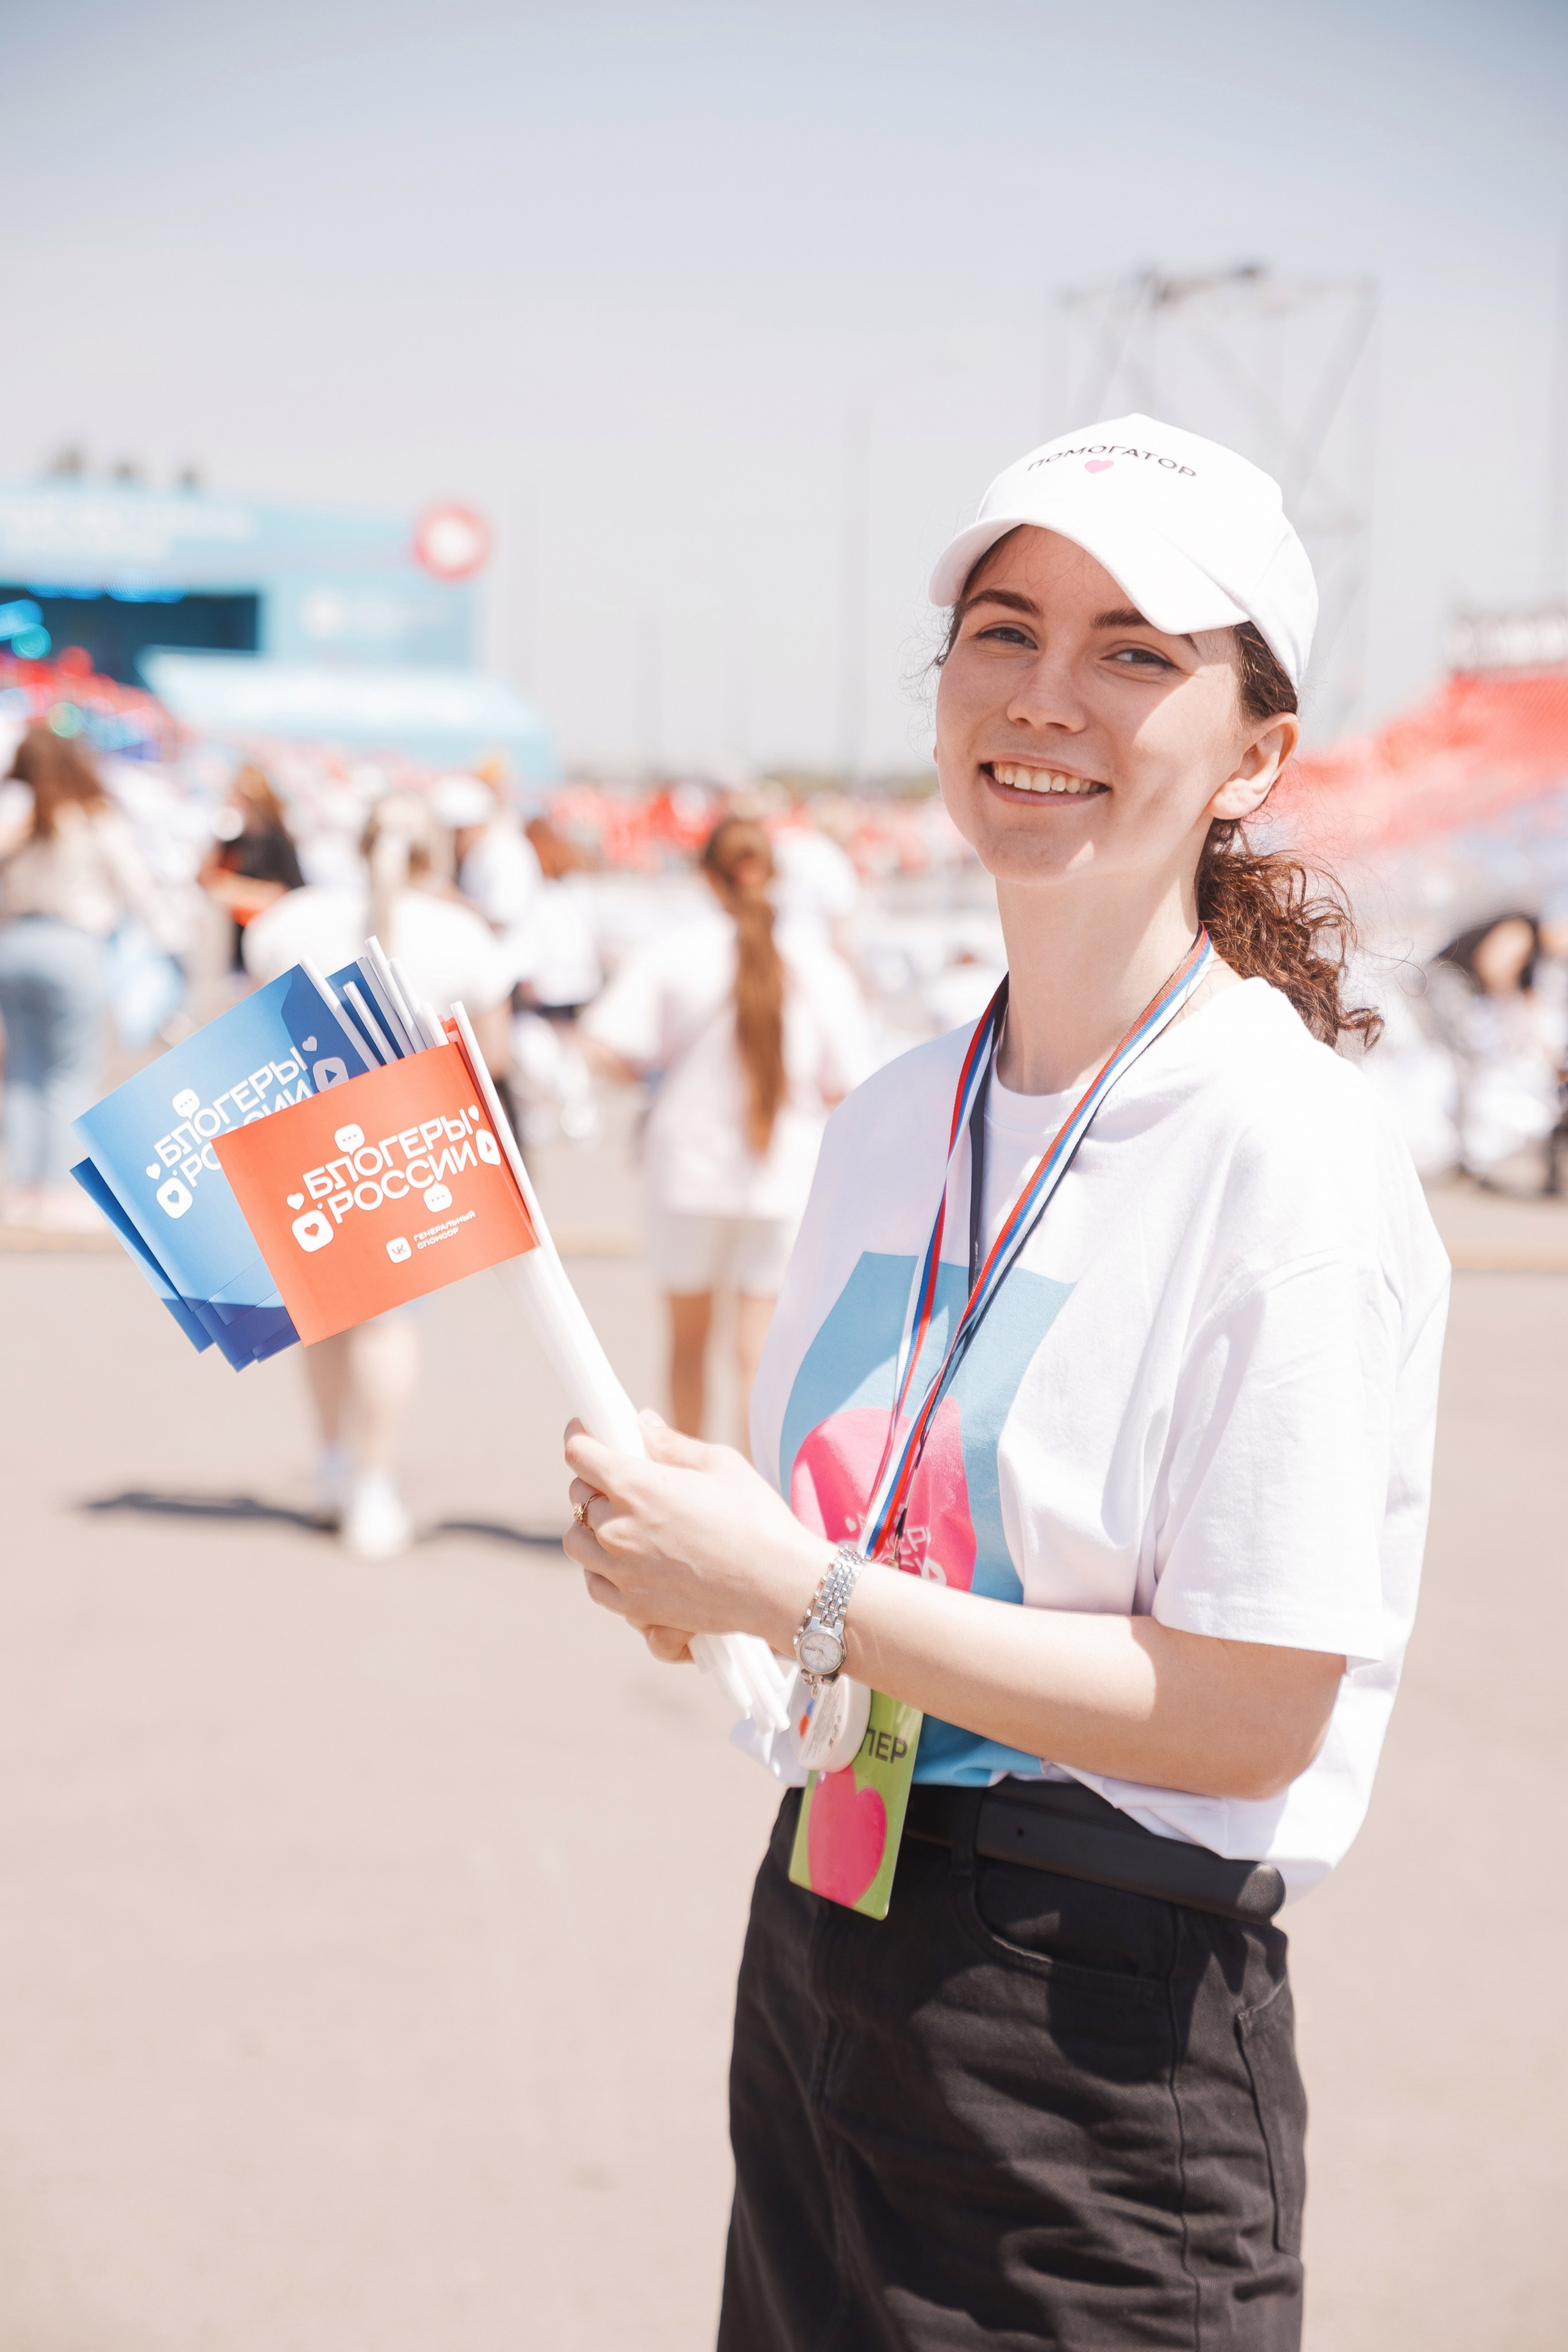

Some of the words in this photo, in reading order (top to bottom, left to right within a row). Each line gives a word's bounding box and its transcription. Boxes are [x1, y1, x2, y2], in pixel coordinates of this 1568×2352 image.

[1027, 445, 1197, 477] ПОМОГАТОР
[153, 1046, 308, 1169] БЛОГЕРЫ
[302, 1108, 474, 1201] БЛОГЕРЫ
[326, 1140, 478, 1225] РОССИИ
[413, 1209, 477, 1243] ГЕНЕРАЛЬНЫЙ
[417, 1226, 459, 1250] СПОНСОР
